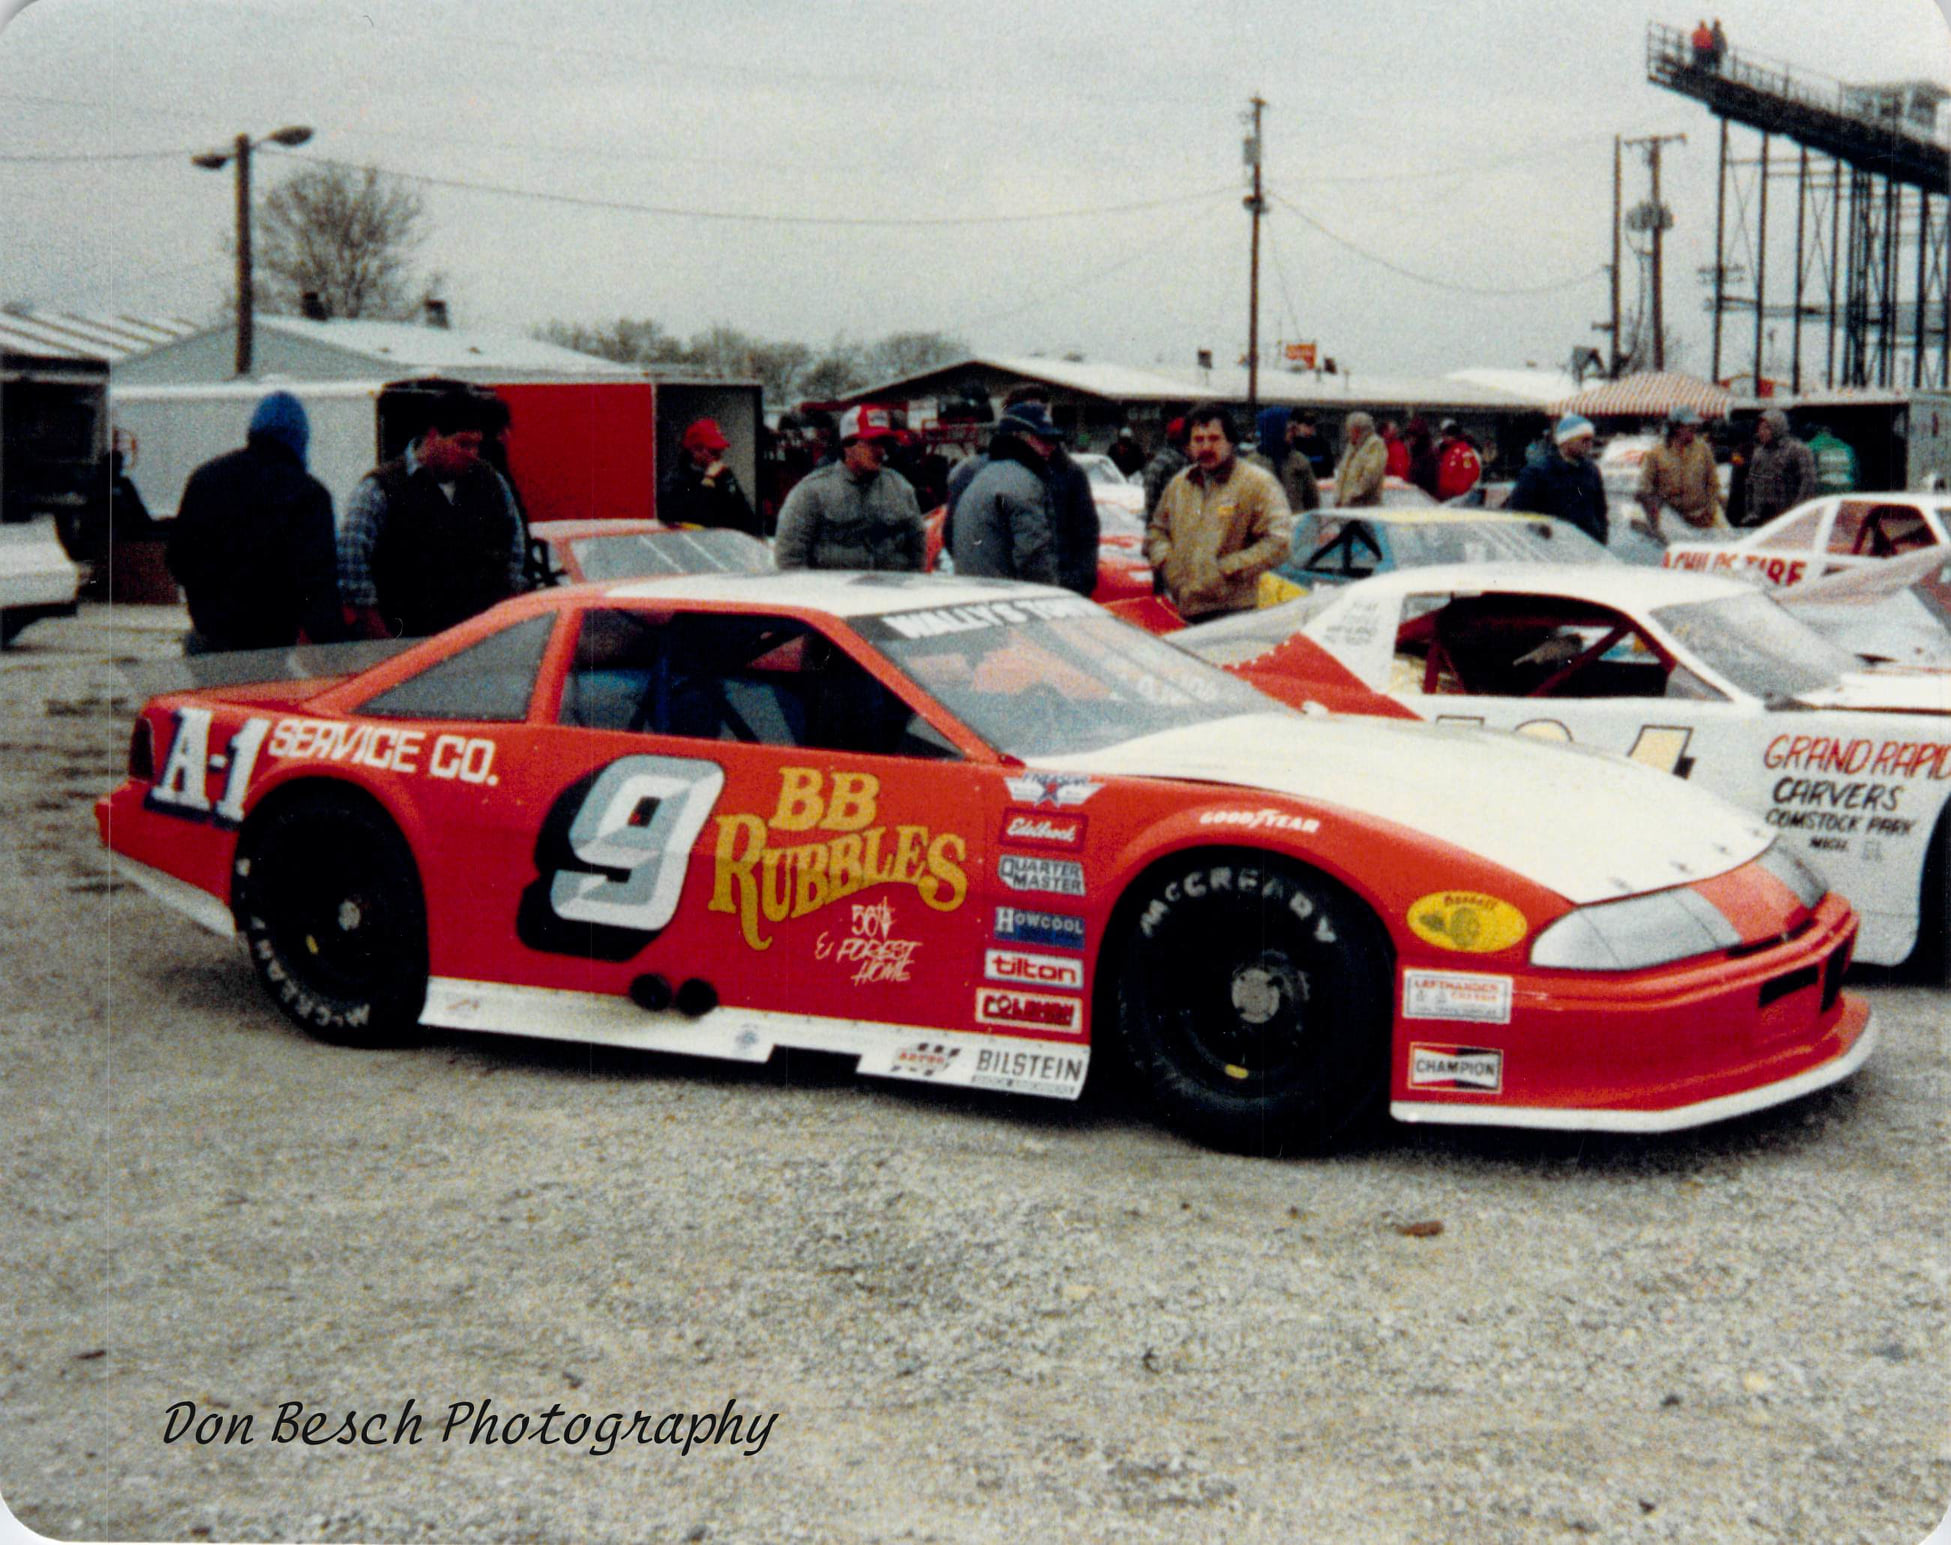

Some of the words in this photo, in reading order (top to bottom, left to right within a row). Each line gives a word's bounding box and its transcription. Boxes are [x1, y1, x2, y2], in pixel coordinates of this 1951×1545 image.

[149, 706, 271, 824] A-1
[268, 718, 427, 774] SERVICE
[429, 734, 500, 787] CO.
[1763, 733, 1873, 776] GRAND
[768, 766, 881, 832] BB
[1772, 776, 1905, 812] CARVERS
[1764, 808, 1864, 833] COMSTOCK
[1866, 817, 1921, 838] PARK
[548, 753, 726, 933] 9
[707, 813, 968, 952] RUBBLES
[1000, 856, 1081, 880] QUARTER
[1012, 874, 1082, 895] MASTER
[992, 955, 1077, 984] tilton
[975, 1049, 1083, 1084] BILSTEIN
[1415, 1057, 1497, 1078] CHAMPION
